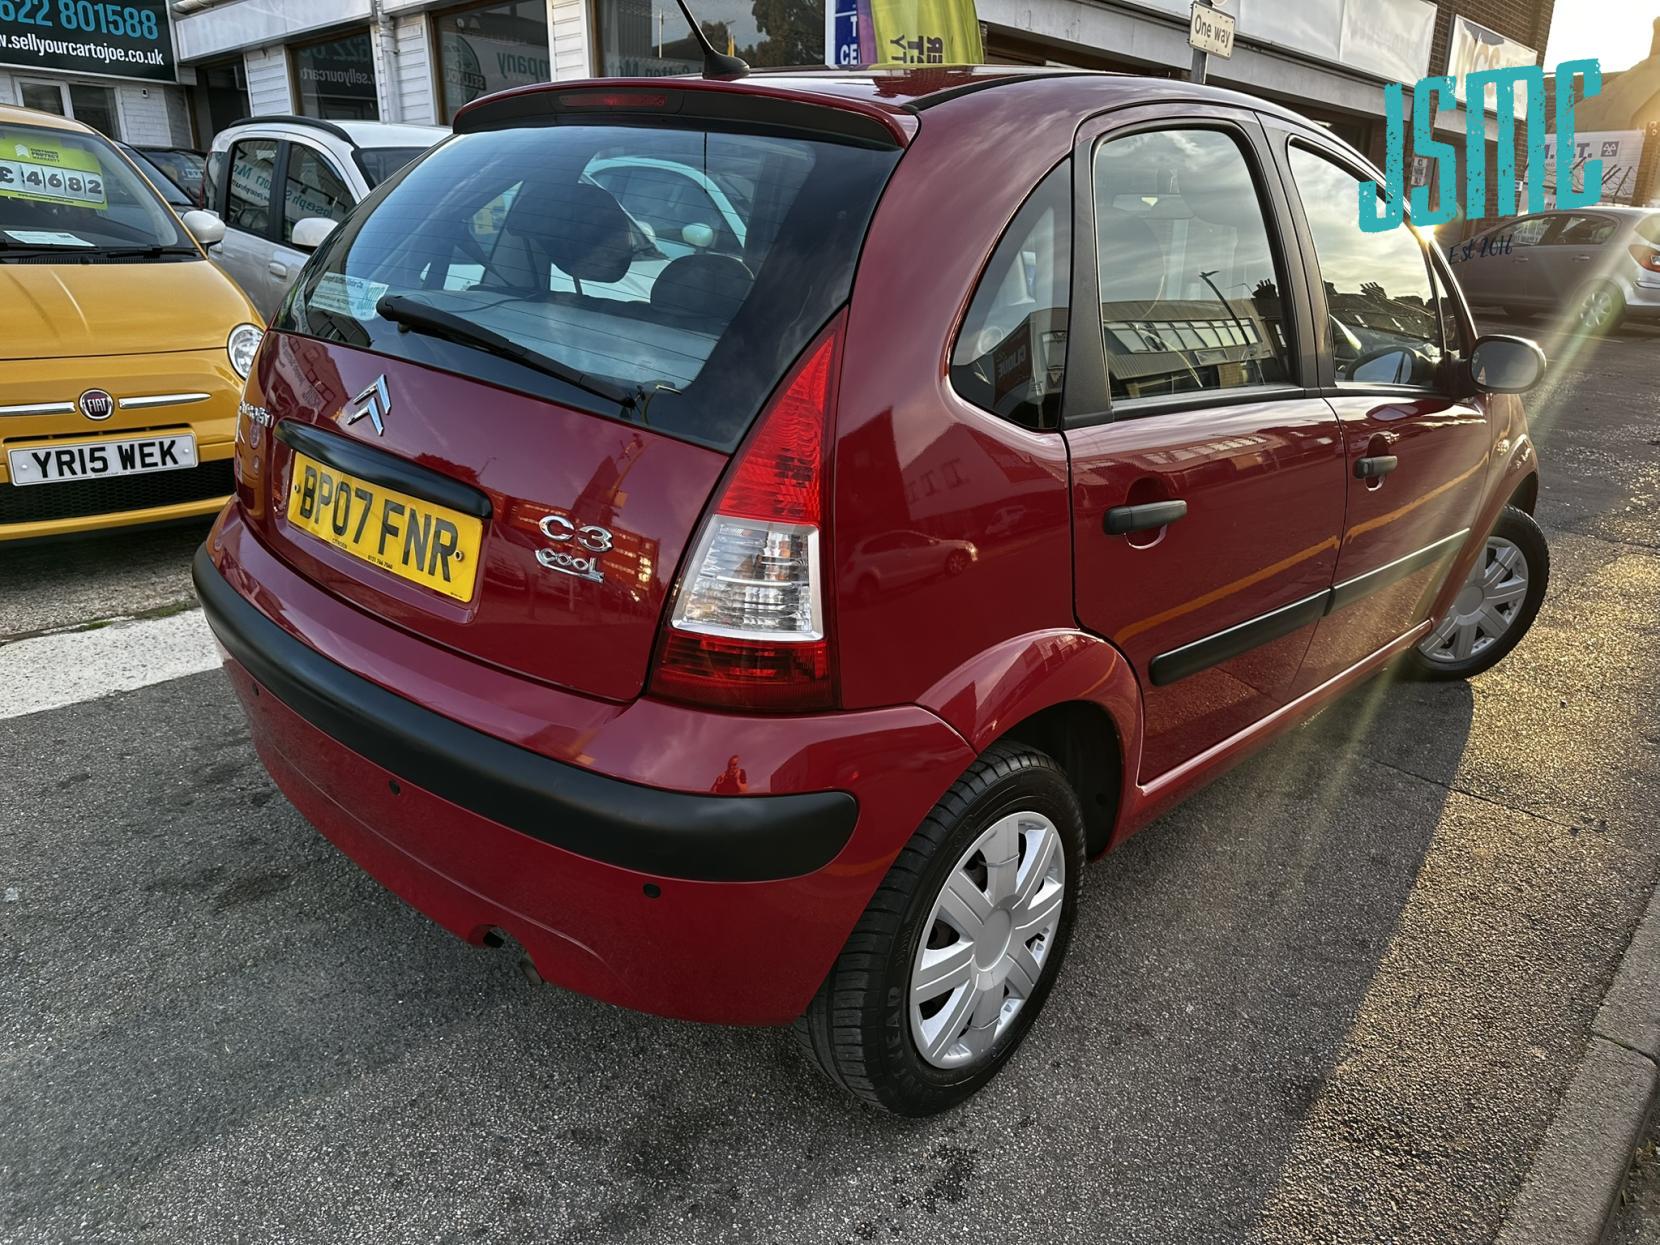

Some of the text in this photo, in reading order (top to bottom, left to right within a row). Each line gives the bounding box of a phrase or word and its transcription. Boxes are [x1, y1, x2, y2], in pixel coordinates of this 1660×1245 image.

[59, 0, 159, 40] 801588
[1195, 14, 1230, 48] One way
[87, 397, 106, 413] FIAT
[32, 440, 178, 478] YR15 WEK
[299, 464, 458, 583] BP07 FNR
[538, 515, 613, 552] C3
